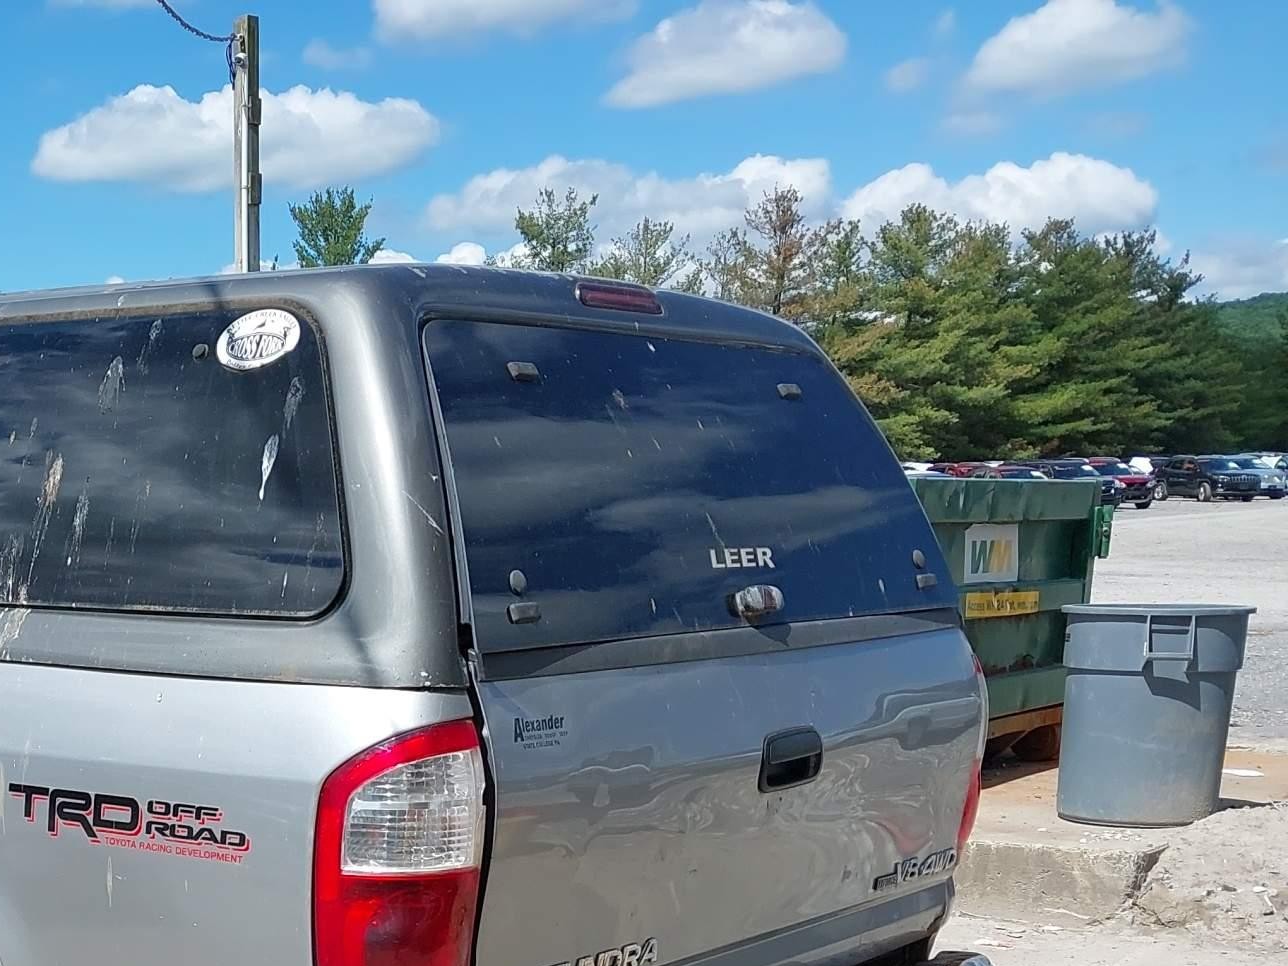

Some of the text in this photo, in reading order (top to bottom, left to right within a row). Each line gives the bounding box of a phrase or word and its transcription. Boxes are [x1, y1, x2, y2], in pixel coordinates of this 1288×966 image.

[228, 335, 259, 360] CROSS
[709, 546, 776, 569] LEER
[970, 539, 1014, 575] WM
[513, 715, 565, 743] Alexander
[8, 782, 144, 844] TRD
[146, 799, 223, 824] OFF
[104, 836, 243, 864] TOYOTA RACING DEVELOPMENT
[145, 820, 251, 852] ROAD
[919, 848, 957, 876] 4WD
